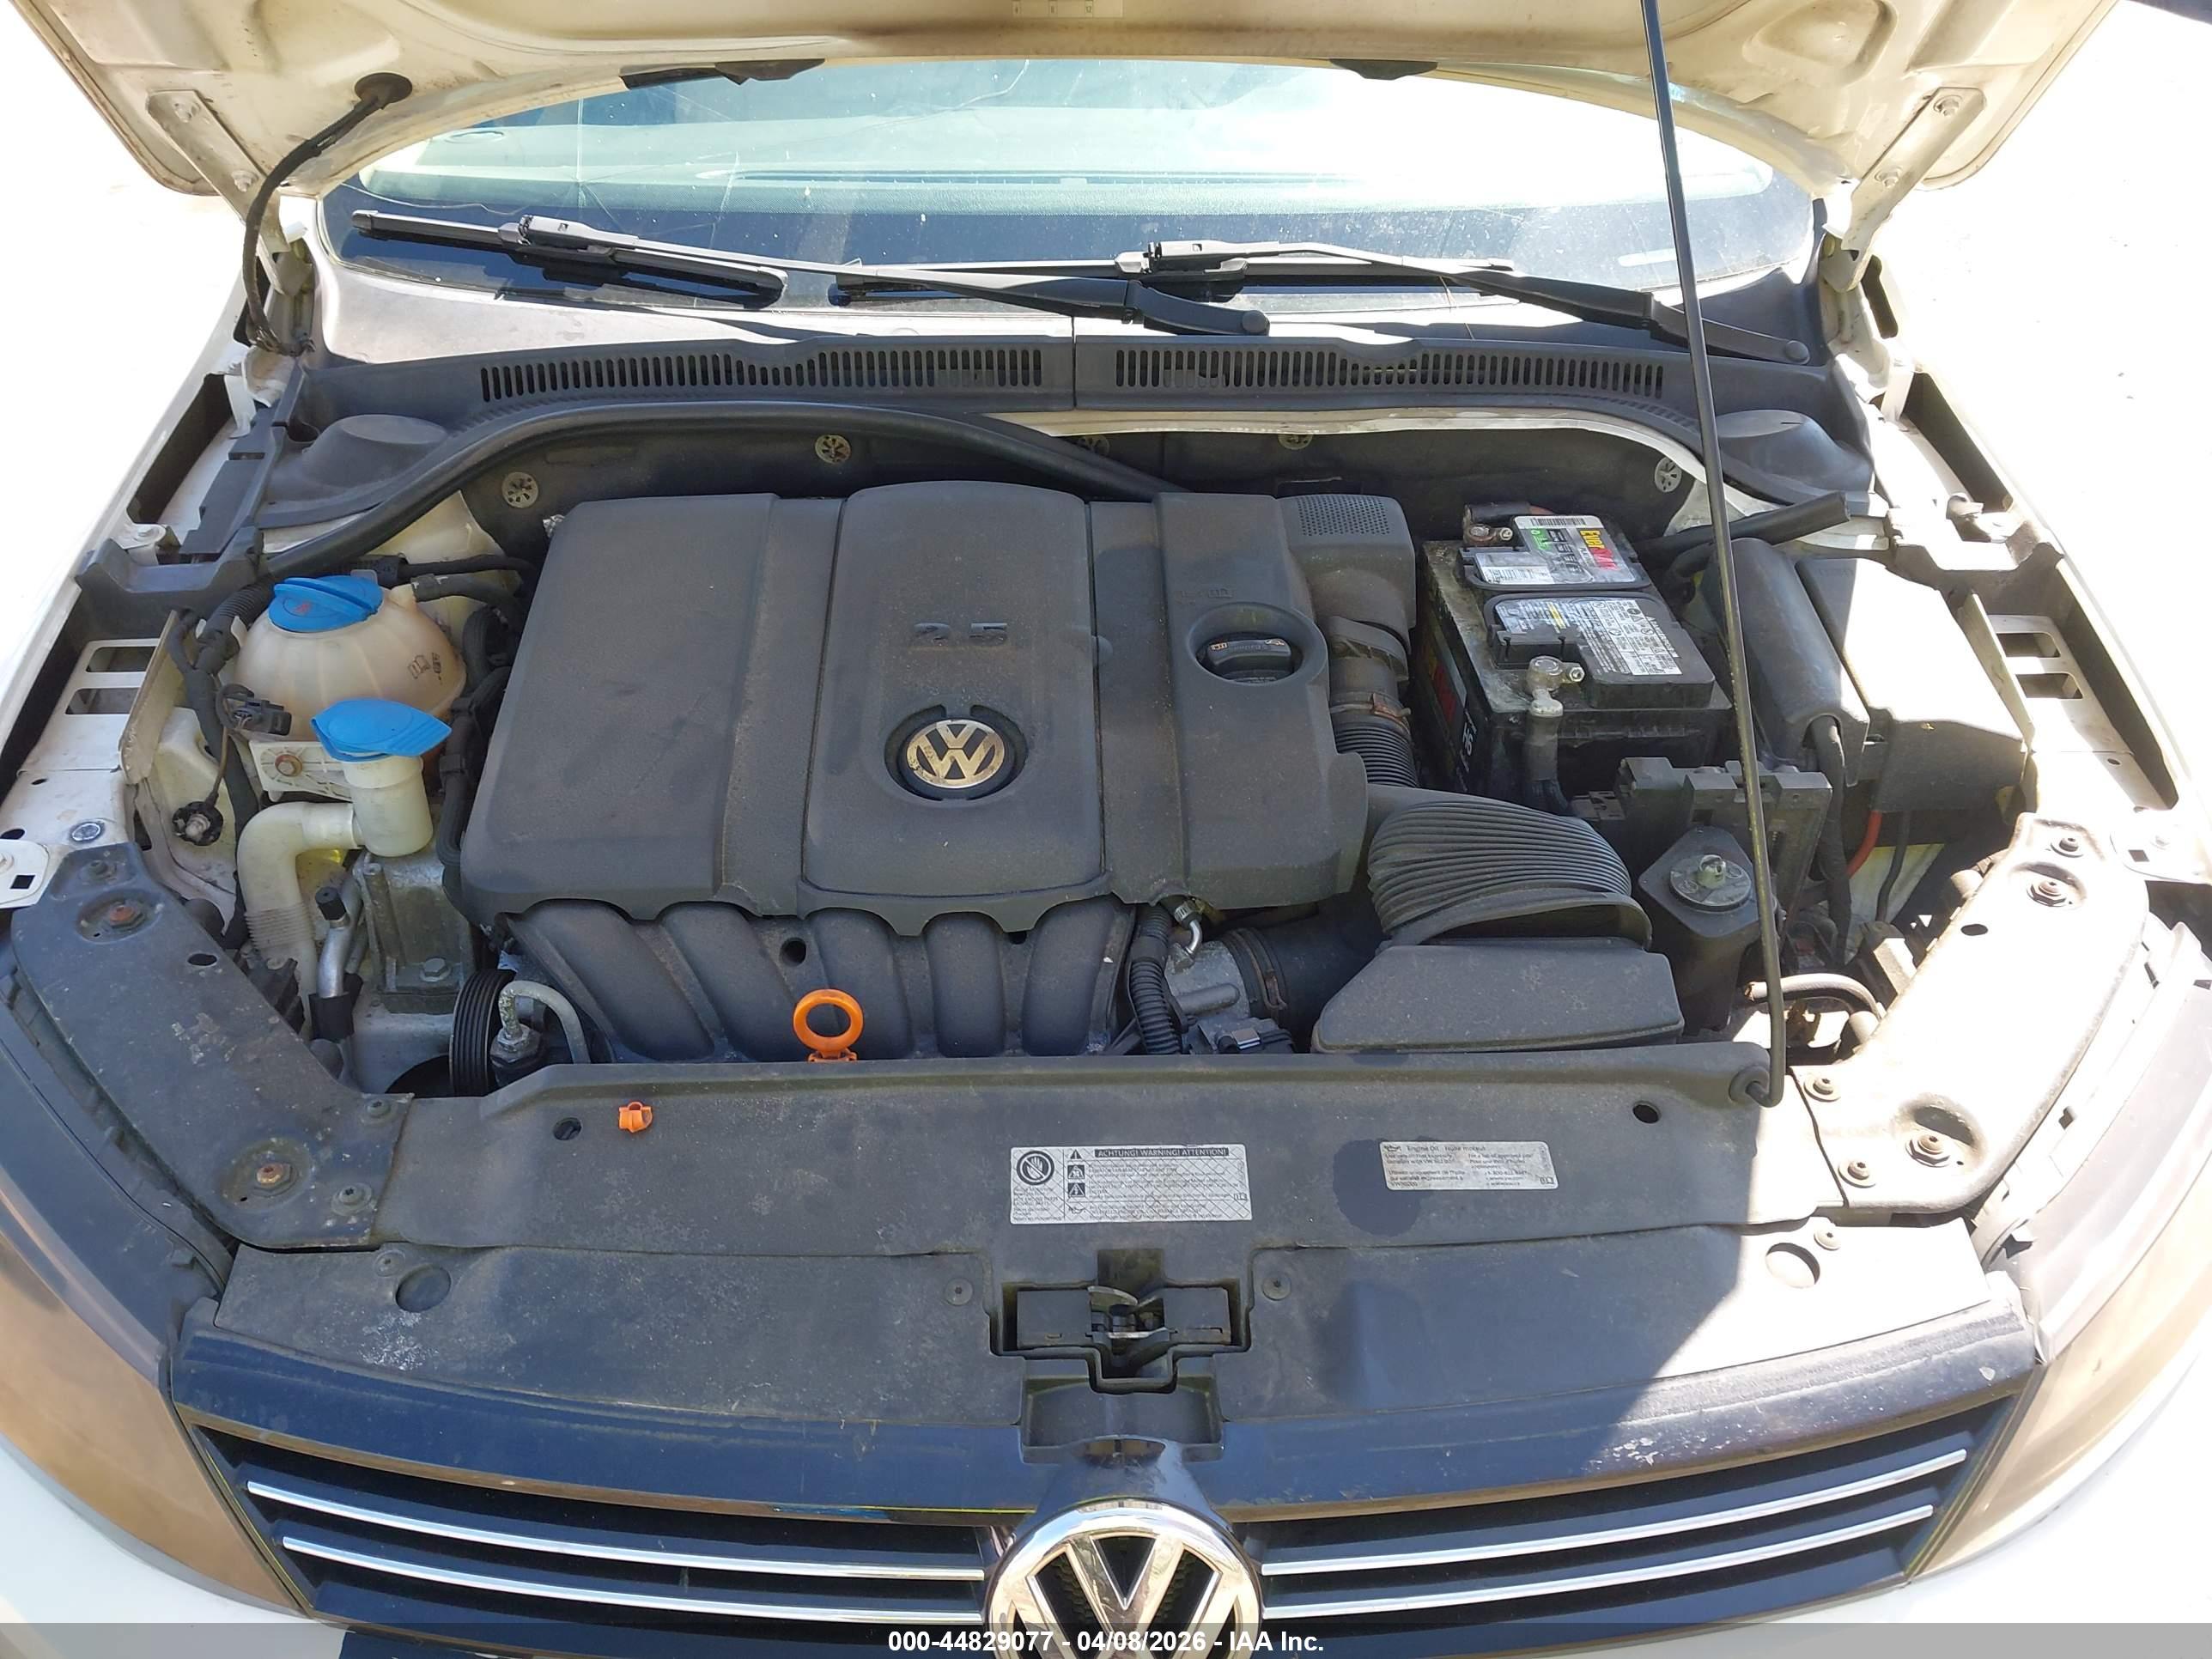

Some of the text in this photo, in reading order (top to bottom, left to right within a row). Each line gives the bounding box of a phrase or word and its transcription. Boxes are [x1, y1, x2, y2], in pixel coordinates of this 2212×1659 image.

[914, 623, 1007, 647] 25
[907, 720, 1005, 788] VW
[1182, 1148, 1227, 1157] ATTENTION!
